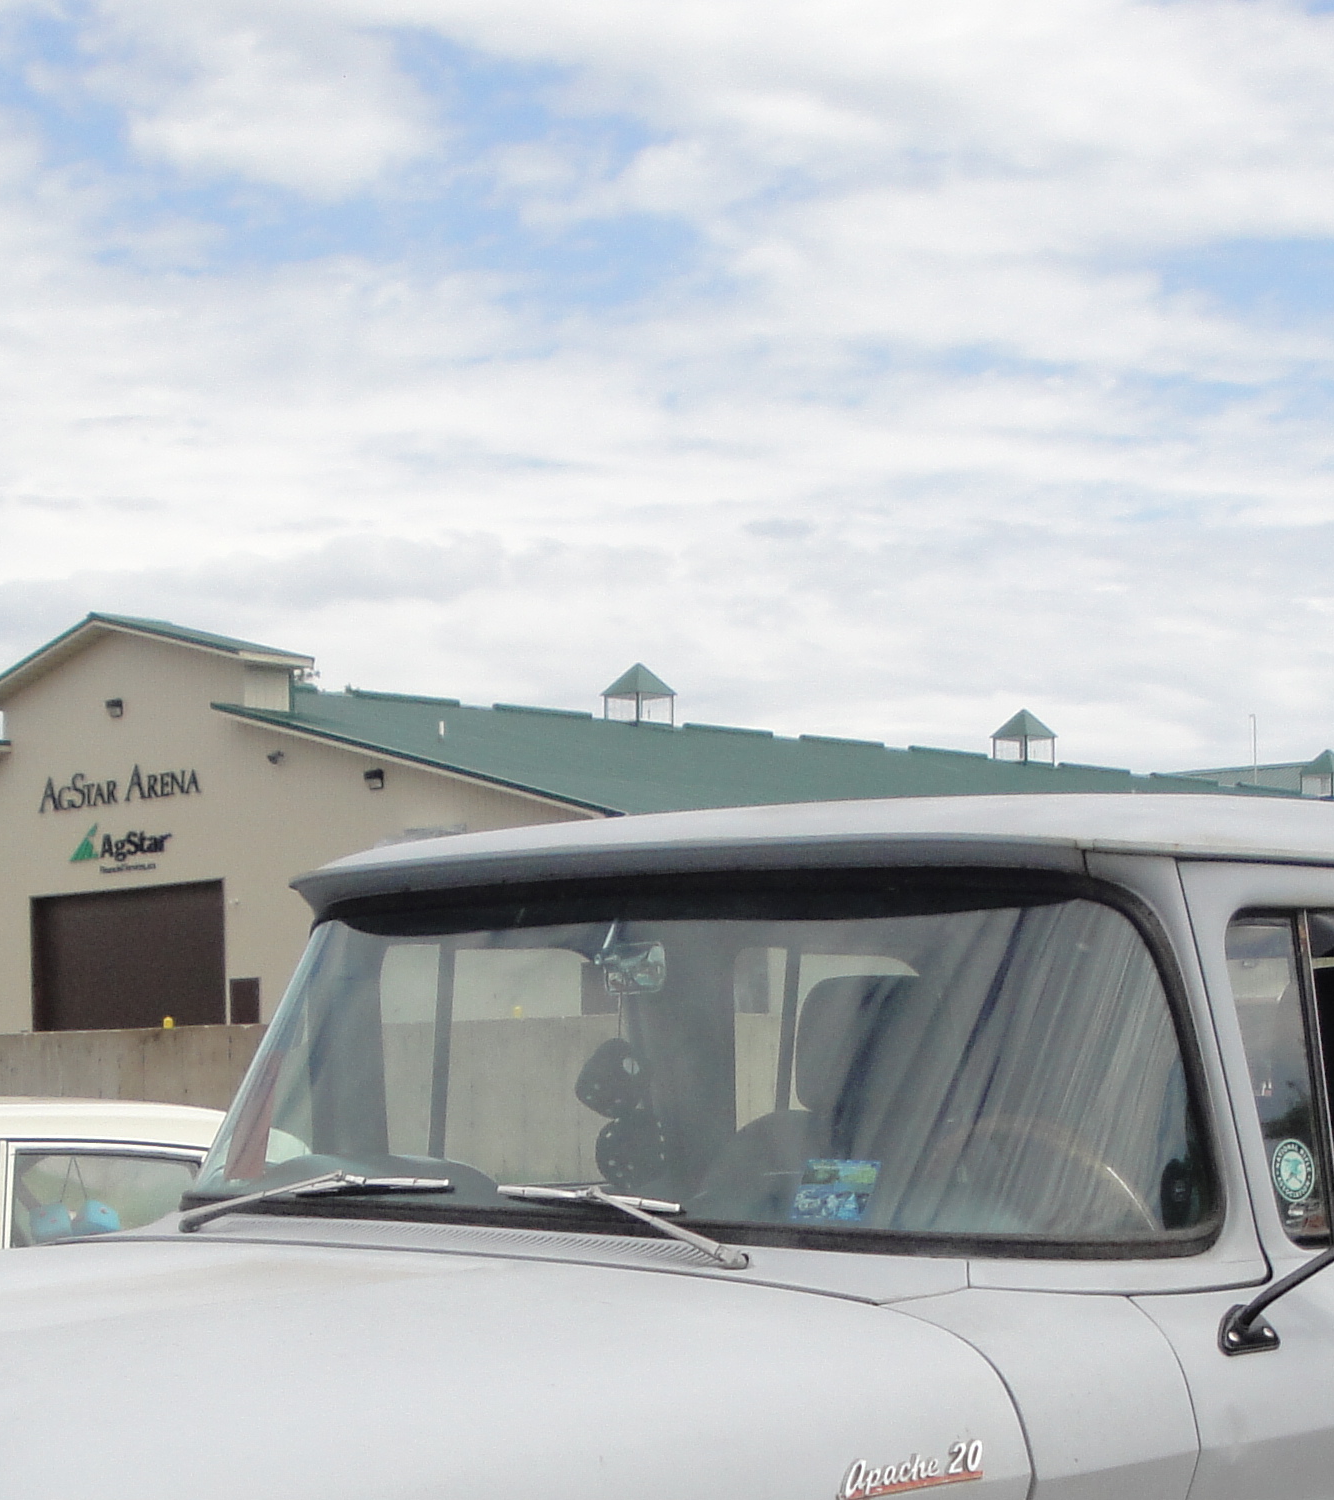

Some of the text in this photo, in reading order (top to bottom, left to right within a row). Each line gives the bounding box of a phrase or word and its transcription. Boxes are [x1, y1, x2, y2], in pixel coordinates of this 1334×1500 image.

[99, 830, 173, 862] AgStar
[838, 1439, 984, 1499] Apache 20
